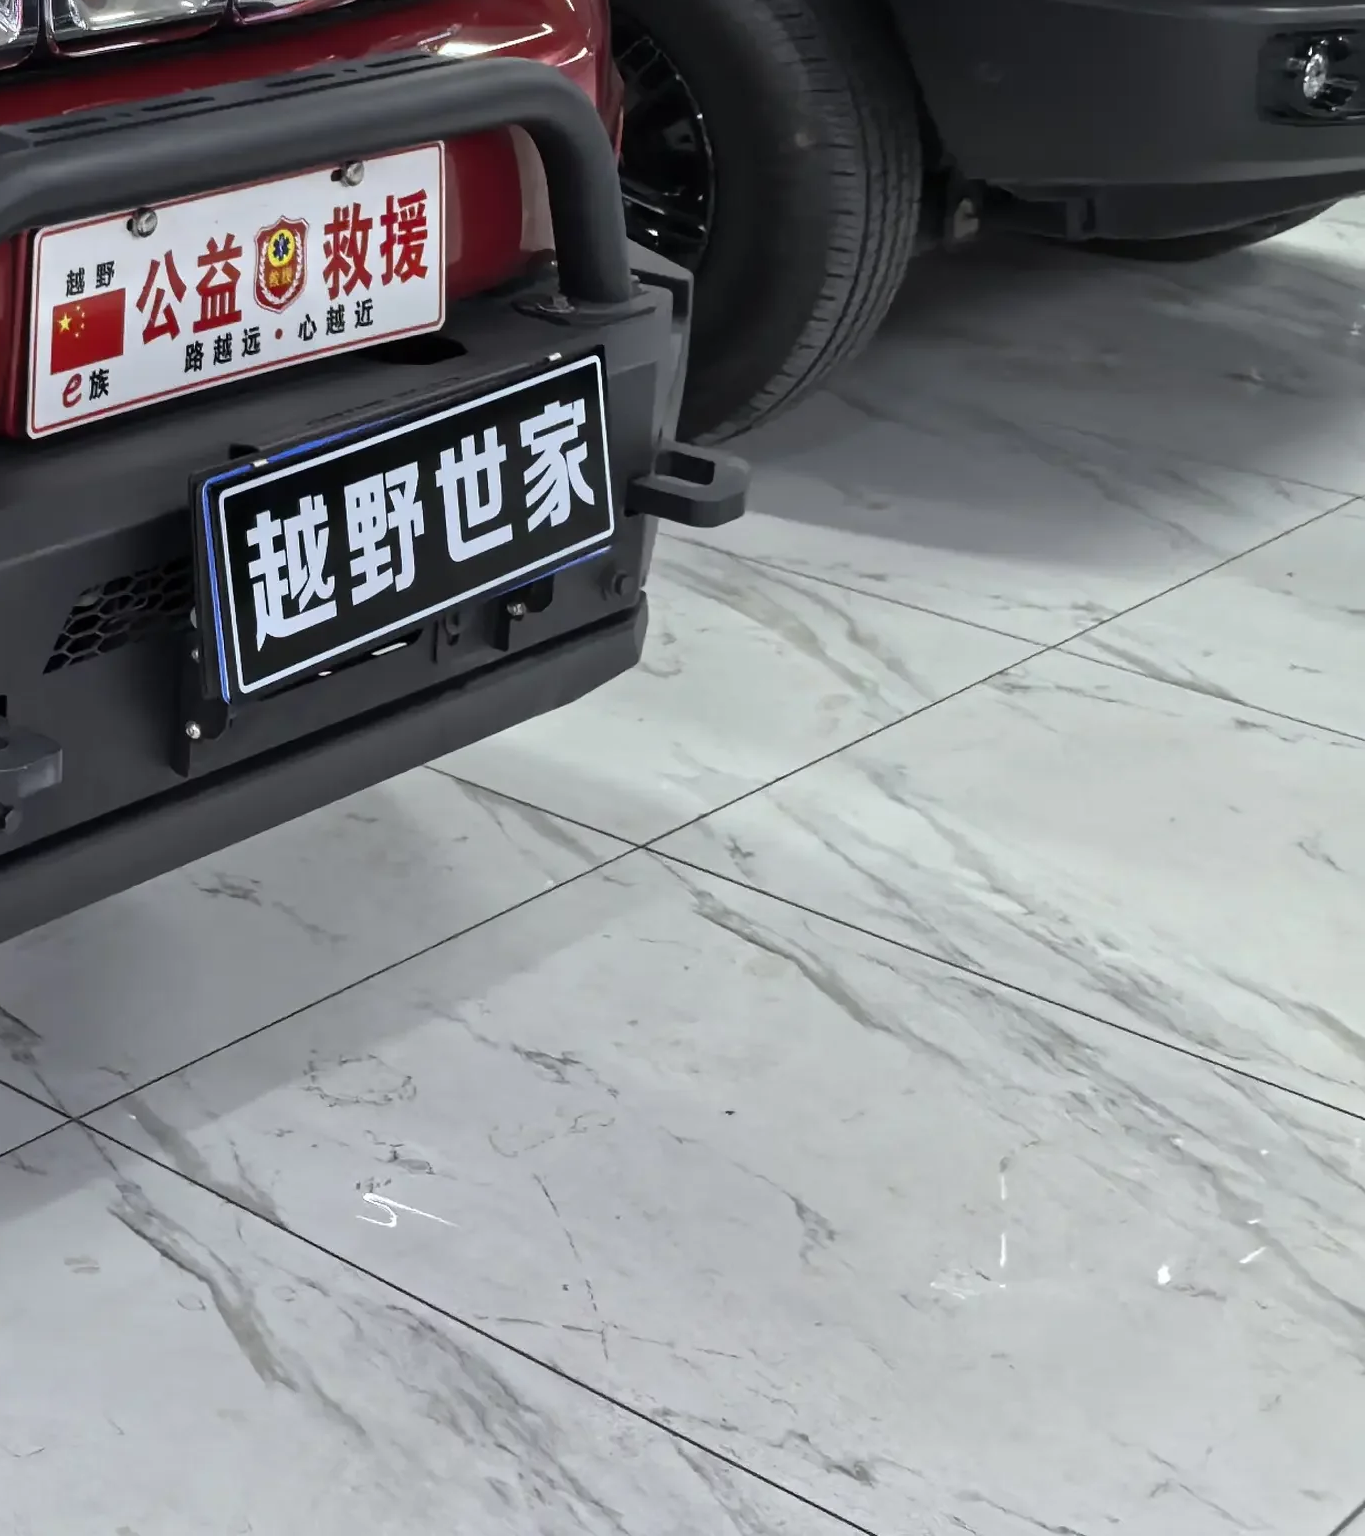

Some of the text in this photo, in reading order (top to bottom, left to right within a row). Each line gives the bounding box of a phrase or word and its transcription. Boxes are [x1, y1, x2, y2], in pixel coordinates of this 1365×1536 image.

[65, 260, 115, 298] 越野
[135, 188, 429, 345] 公益 救援
[62, 368, 110, 409] e族
[246, 397, 595, 652] 越野世家
